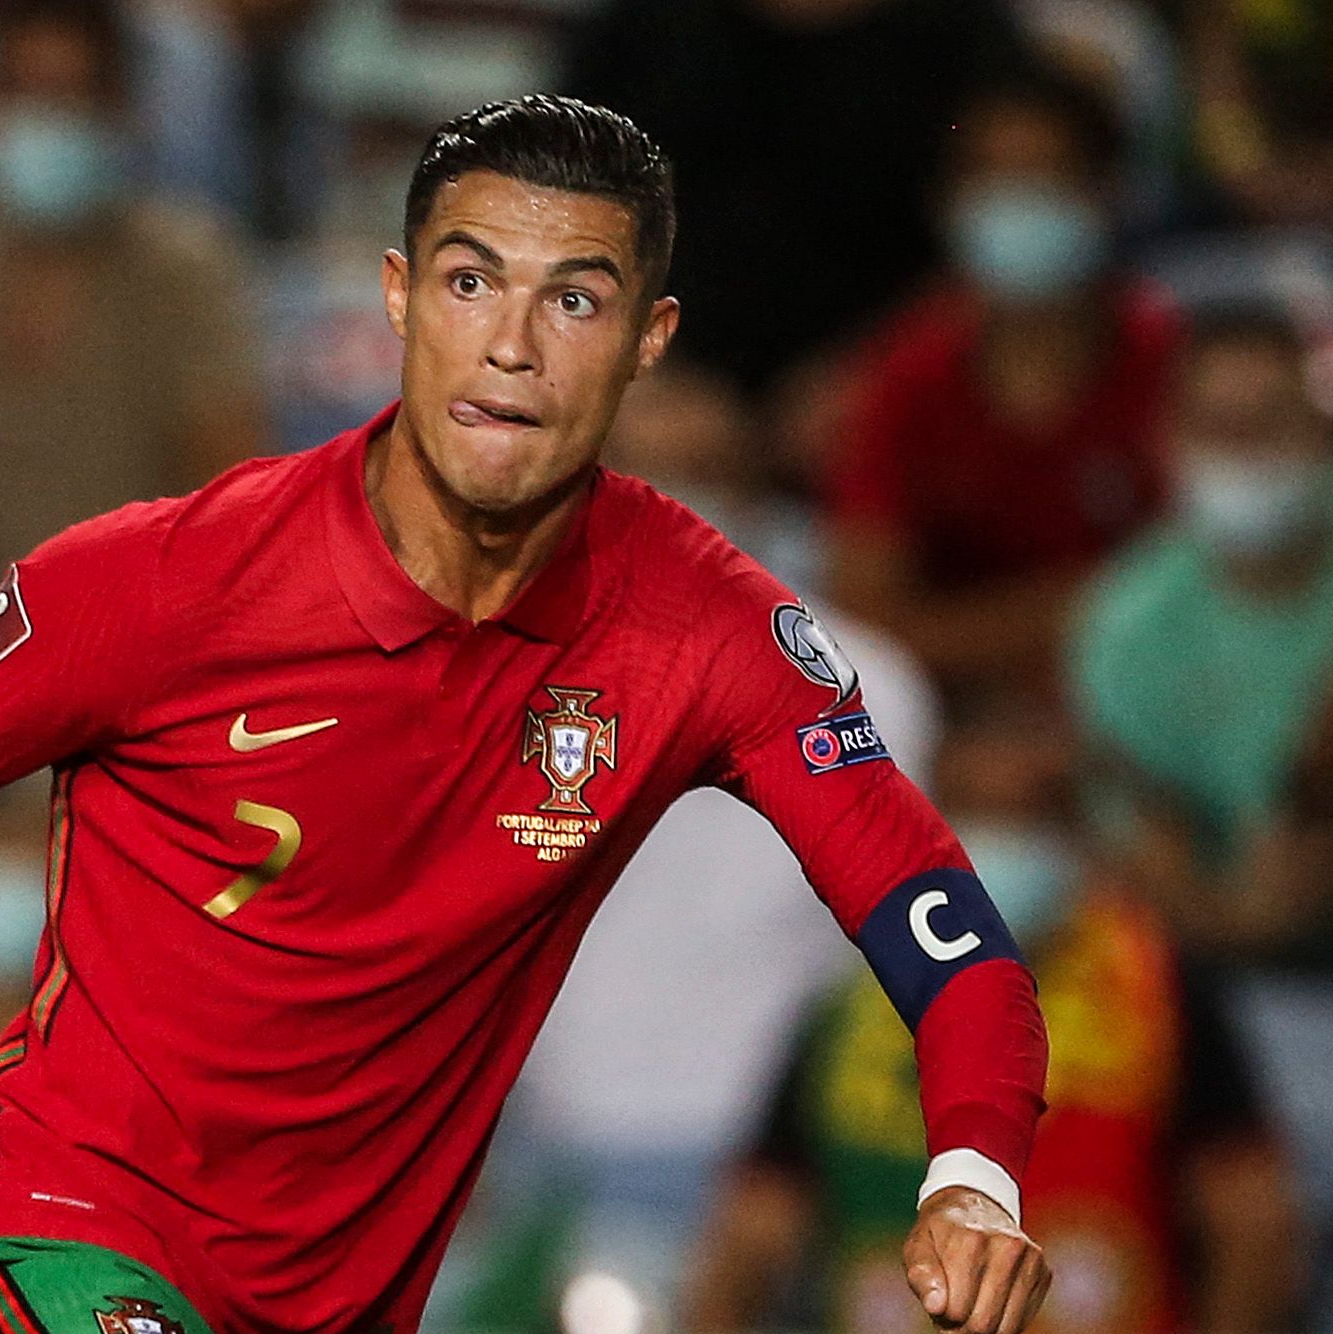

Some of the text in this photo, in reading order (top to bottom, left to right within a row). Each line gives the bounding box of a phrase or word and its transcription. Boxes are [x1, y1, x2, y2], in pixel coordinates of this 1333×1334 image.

[840, 726, 878, 751] RES
[202, 799, 302, 920] 7
[521, 831, 586, 848] SETEMBRO
[909, 889, 982, 962] C
